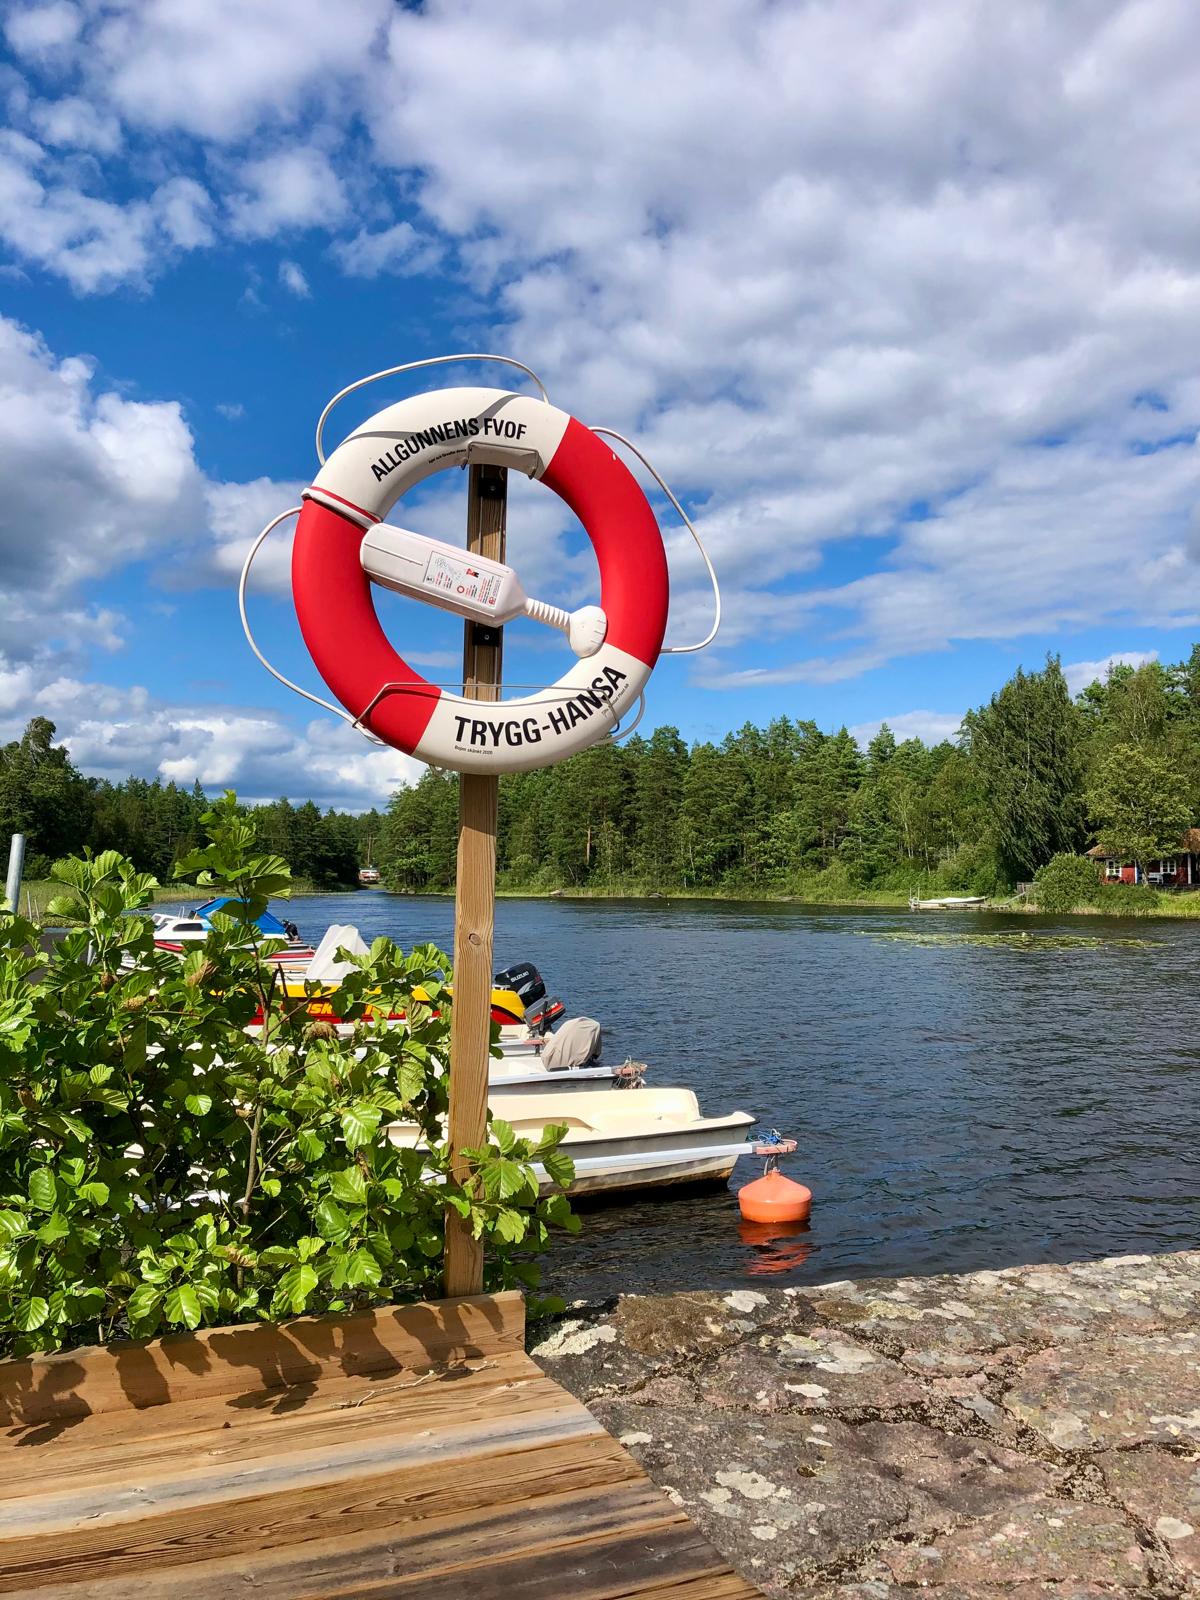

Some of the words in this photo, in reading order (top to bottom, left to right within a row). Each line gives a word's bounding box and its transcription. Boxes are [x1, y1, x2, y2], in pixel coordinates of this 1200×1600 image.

[370, 417, 479, 481] ALLGUNNENS
[484, 417, 527, 440] FVOF
[454, 666, 627, 747] TRYGG-HANSA
[510, 971, 529, 983] SUZUKI
